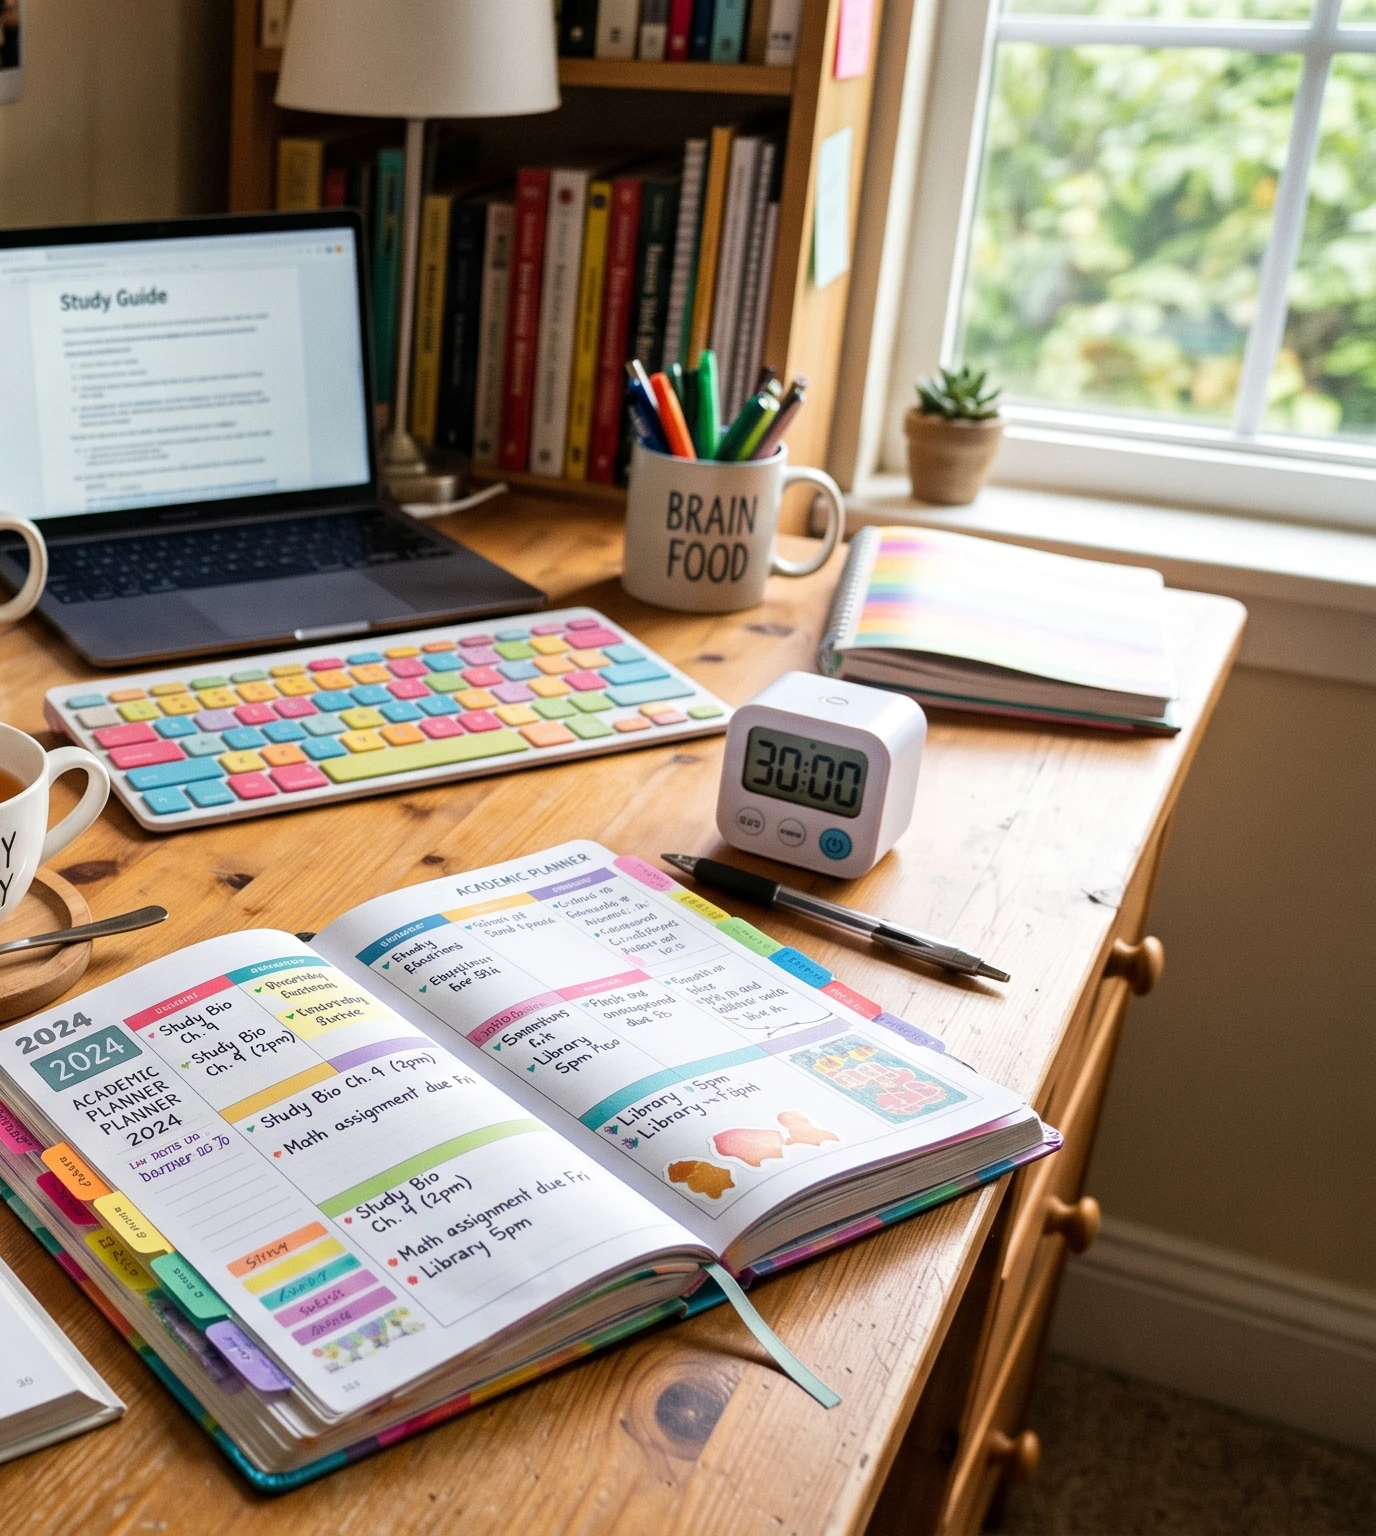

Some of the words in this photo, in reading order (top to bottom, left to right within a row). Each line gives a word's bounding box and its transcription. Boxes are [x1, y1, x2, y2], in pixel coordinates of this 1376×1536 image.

[59, 290, 112, 313] Study
[115, 286, 167, 307] Guide
[666, 490, 758, 537] BRAIN
[667, 538, 749, 583] FOOD
[753, 740, 861, 808] 30:00
[456, 871, 527, 896] ACADEMIC
[528, 853, 592, 877] PLANNER
[14, 1011, 92, 1055] 2024
[159, 1011, 205, 1039] Study
[205, 1001, 232, 1017] Bio
[49, 1035, 124, 1081] 2024
[191, 1039, 240, 1067] Study
[239, 1027, 266, 1044] Bio
[250, 1030, 297, 1059] (2pm)
[72, 1066, 160, 1111] ACADEMIC
[85, 1080, 171, 1123] PLANNER
[261, 1100, 313, 1131] Study
[312, 1083, 342, 1106] Bio
[345, 1068, 372, 1089] Ch.
[390, 1051, 437, 1074] (2pm)
[616, 1092, 684, 1127] Library
[99, 1093, 182, 1136] PLANNER
[126, 1113, 183, 1147] 2024
[282, 1124, 329, 1156] Math
[334, 1087, 420, 1133] assignment
[426, 1075, 452, 1093] due
[637, 1103, 708, 1139] Library
[355, 1185, 411, 1221] Study
[411, 1171, 440, 1191] Bio
[372, 1212, 403, 1234] Ch.
[403, 1204, 418, 1219] 4
[420, 1174, 473, 1211] (2pm)
[397, 1233, 444, 1264] Math
[447, 1189, 533, 1240] assignment
[536, 1177, 563, 1196] due
[564, 1169, 591, 1186] Fri
[420, 1238, 493, 1279] Library
[491, 1216, 533, 1244] 5pm
